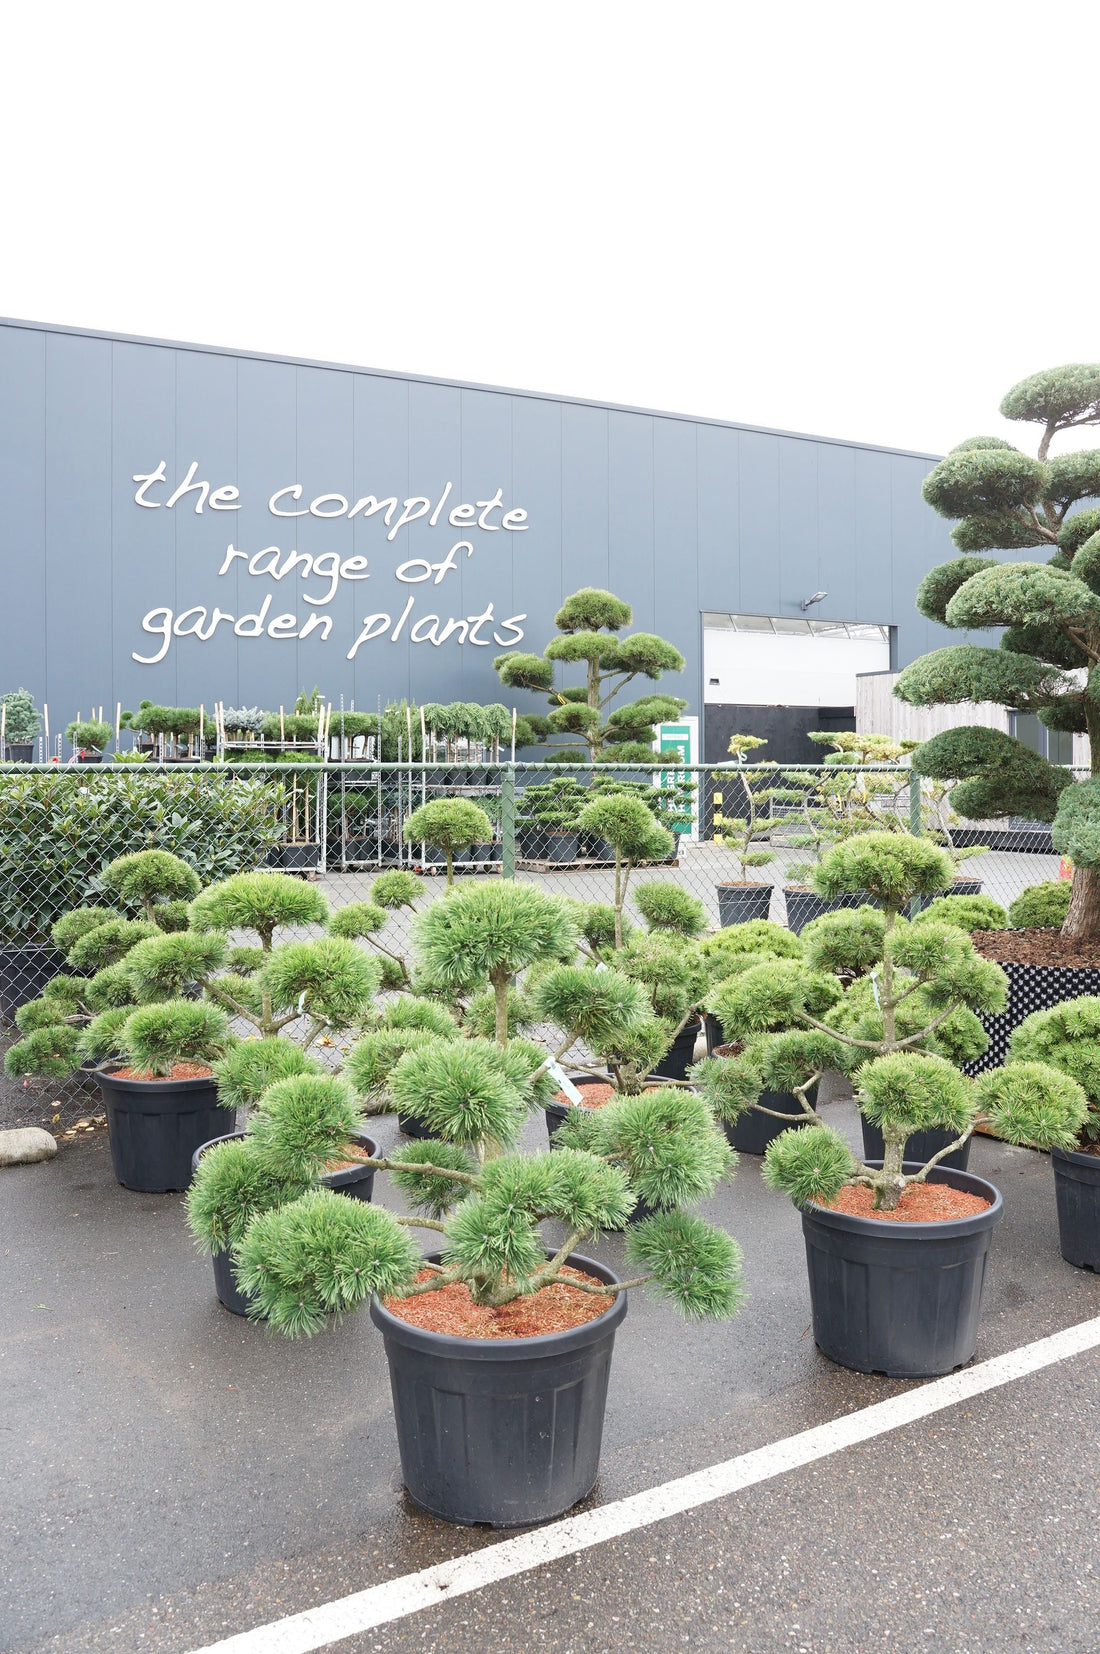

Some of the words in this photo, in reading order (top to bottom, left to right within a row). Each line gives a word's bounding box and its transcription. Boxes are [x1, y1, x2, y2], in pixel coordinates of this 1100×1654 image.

[132, 460, 242, 514] the
[268, 481, 530, 542] complete
[218, 543, 371, 605] range
[395, 540, 474, 585] of
[132, 593, 334, 664] garden
[346, 595, 528, 661] plants
